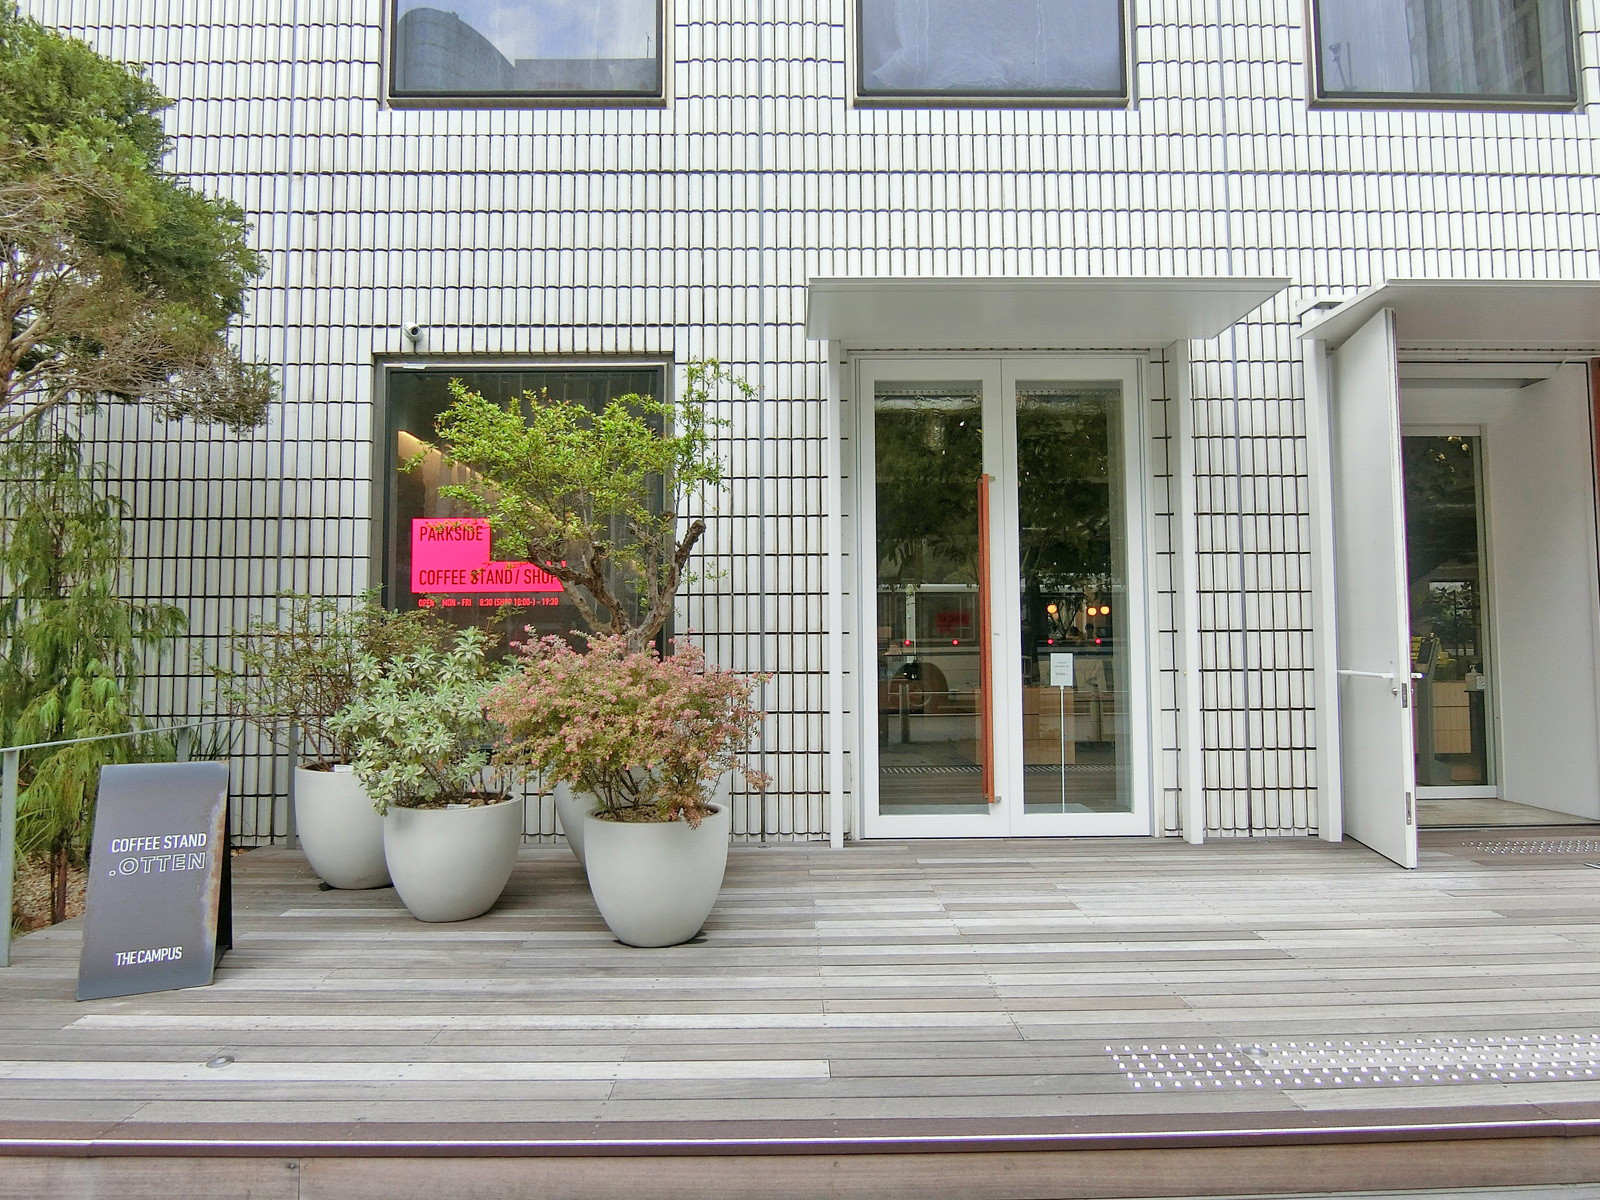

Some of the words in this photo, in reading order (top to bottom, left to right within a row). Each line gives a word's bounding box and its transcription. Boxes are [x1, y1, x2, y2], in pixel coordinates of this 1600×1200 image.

[419, 525, 483, 542] PARKSIDE
[419, 569, 467, 585] COFFEE
[471, 568, 513, 585] STAND
[514, 569, 520, 584] /
[461, 598, 472, 607] FRI
[542, 597, 559, 606] 19:30
[111, 836, 161, 853] COFFEE
[163, 833, 207, 849] STAND
